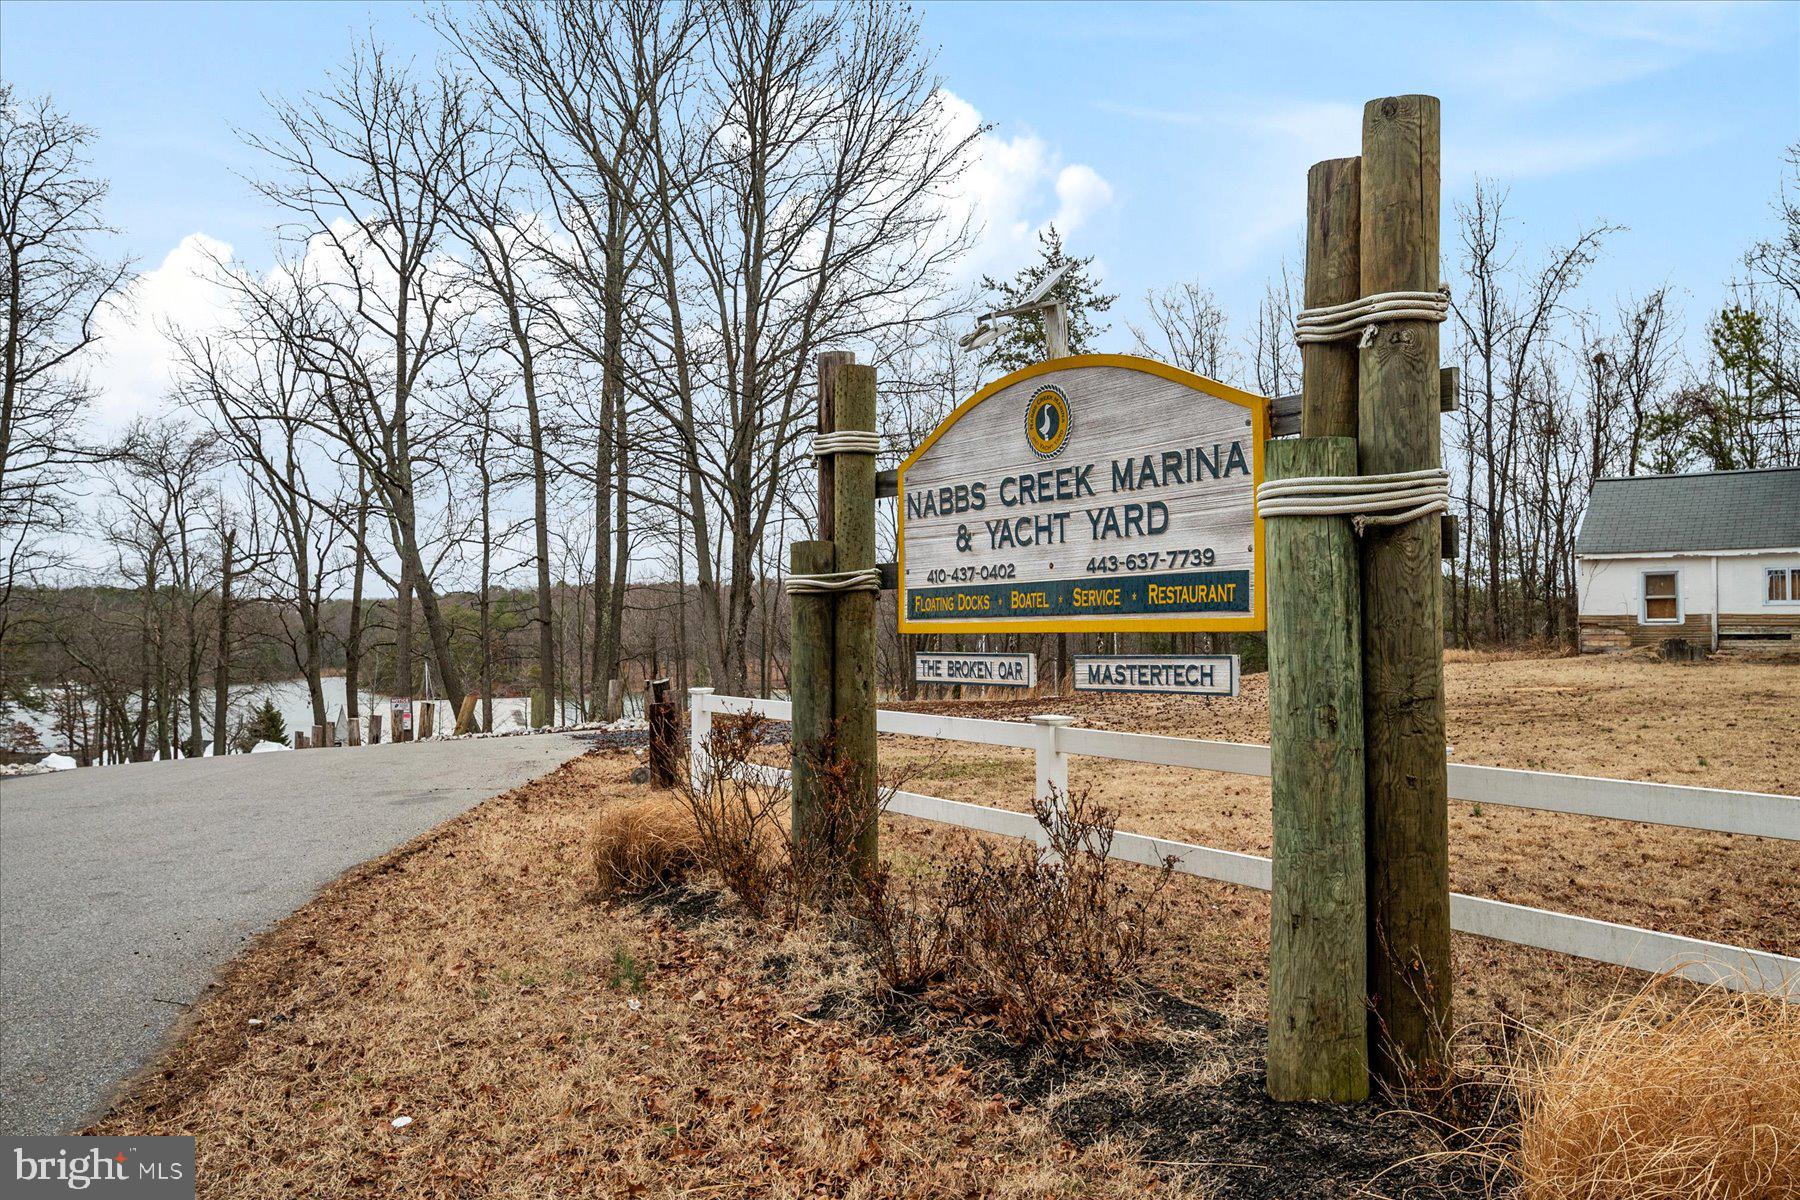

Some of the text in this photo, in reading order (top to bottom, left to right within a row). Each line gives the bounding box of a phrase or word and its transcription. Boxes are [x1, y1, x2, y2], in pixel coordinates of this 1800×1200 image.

[907, 441, 1251, 520] NABBS CREEK MARINA
[956, 500, 1170, 553] & YACHT YARD
[1086, 548, 1215, 573] 443-637-7739
[927, 563, 1016, 584] 410-437-0402
[915, 583, 1237, 612] FLOATING DOCKS BOATEL SERVICE RESTAURANT
[920, 659, 1023, 680] THE BROKEN OAR
[1088, 664, 1215, 687] MASTERTECH
